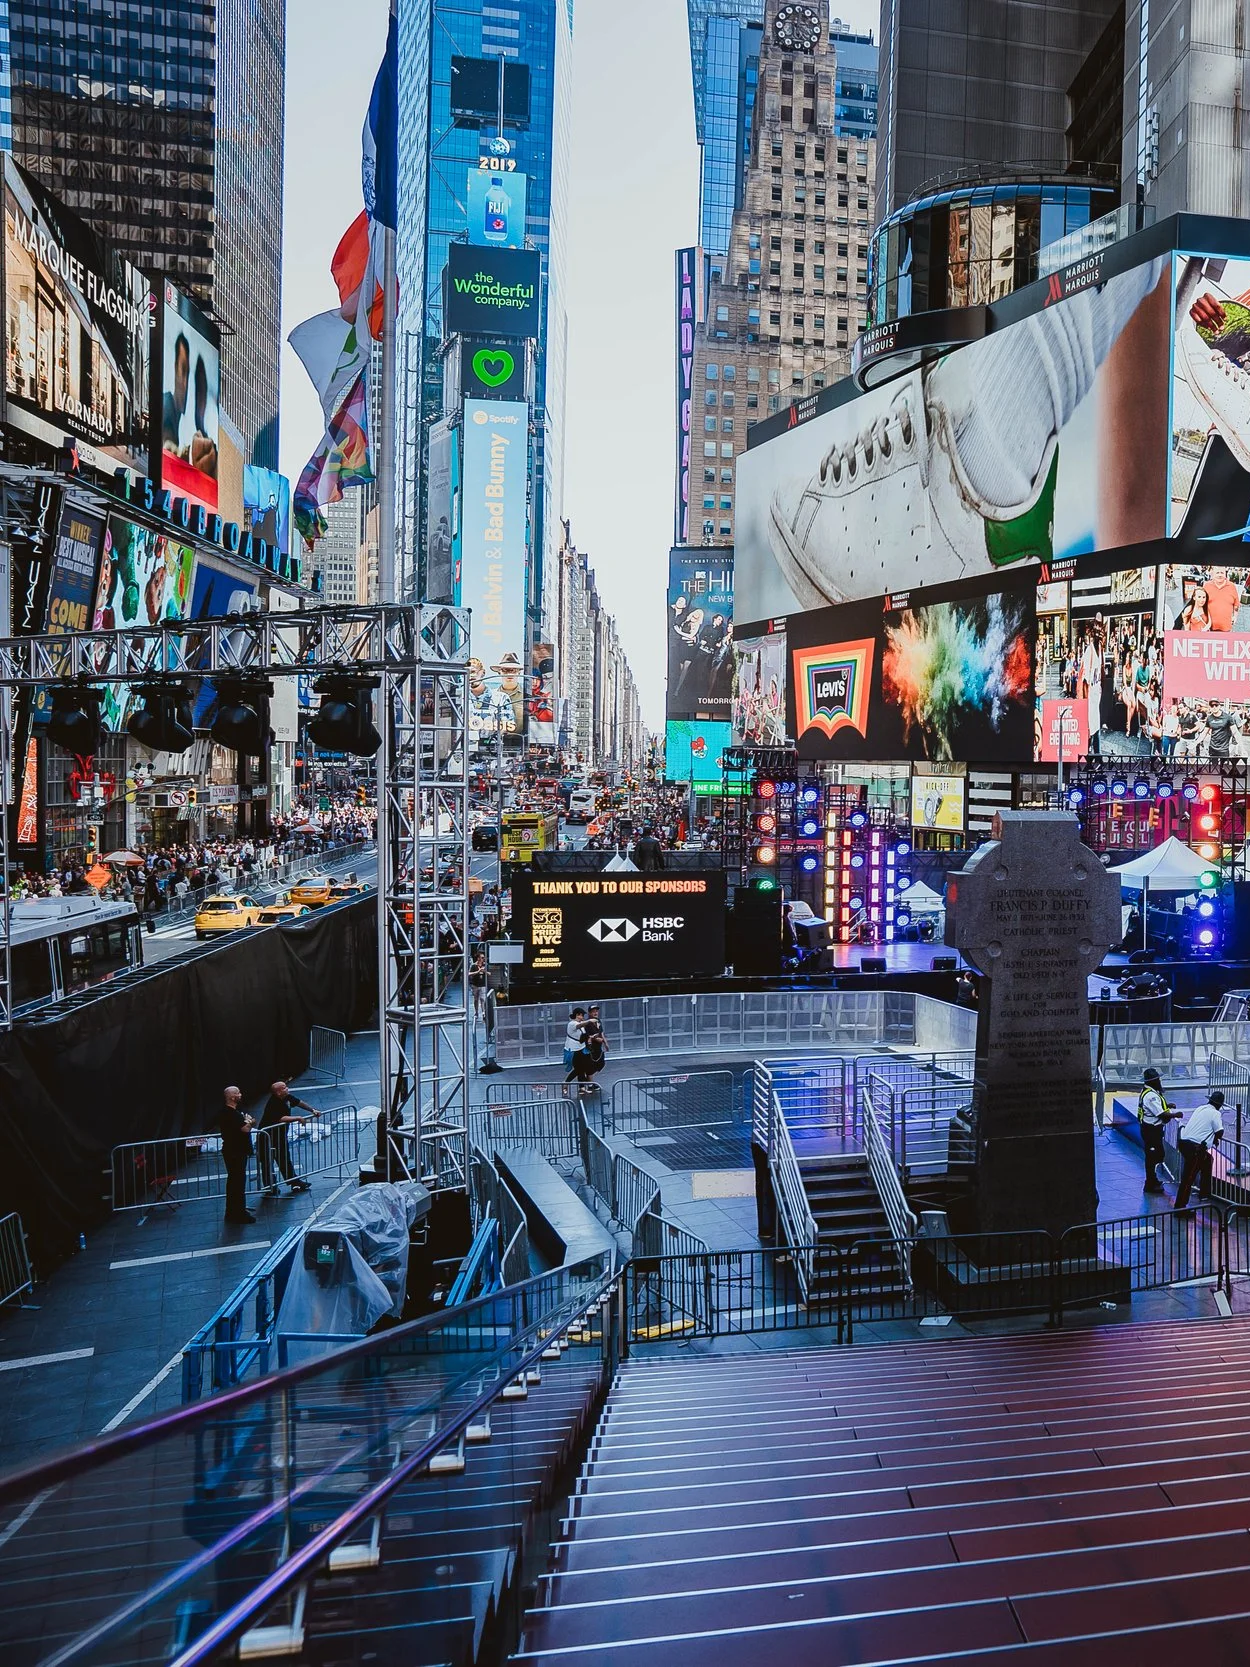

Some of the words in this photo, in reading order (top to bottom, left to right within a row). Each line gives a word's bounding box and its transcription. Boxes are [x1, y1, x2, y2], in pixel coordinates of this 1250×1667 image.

[479, 156, 517, 172] 2019
[488, 201, 505, 214] FIJI
[1065, 253, 1105, 279] MARRIOTT
[14, 208, 85, 294] MARQUEE
[87, 269, 145, 341] FLAGSHIPS
[475, 272, 493, 283] the
[1065, 268, 1100, 293] MARQUIS
[454, 278, 534, 300] Wonderful
[682, 252, 693, 388] LADY
[863, 322, 900, 344] MARRIOTT
[862, 337, 895, 357] MARQUIS
[798, 395, 819, 411] MARRIOTT
[60, 390, 113, 437] VORNADO
[489, 414, 519, 426] Spotify
[798, 407, 816, 421] MARQUIS
[67, 418, 88, 434] REALTY
[88, 429, 105, 443] TRUST
[485, 433, 510, 498] Bunny
[484, 502, 504, 542] Bad
[485, 547, 502, 560] &
[1052, 559, 1077, 570] MARRIOTT
[681, 580, 705, 593] THE
[709, 570, 735, 592] HI
[1052, 569, 1075, 580] MARQUIS
[482, 564, 503, 626] Balvin
[1114, 586, 1151, 602] SEPHORA
[51, 598, 88, 630] COME
[698, 697, 734, 705] TOMORRO
[532, 881, 573, 895] THANK
[575, 881, 600, 894] YOU
[601, 881, 618, 894] TO
[619, 881, 644, 894] OUR
[645, 880, 707, 894] SPONSORS
[997, 889, 1043, 898] LIEUTENANT
[1046, 889, 1084, 897] COLONEL
[990, 900, 1037, 911] FRANCIS
[1041, 900, 1048, 911] P
[1053, 899, 1091, 911] DUFFY
[643, 917, 684, 929] HSBC
[997, 914, 1011, 922] MAY
[643, 931, 674, 942] Bank
[1003, 928, 1044, 936] CATHOLIC
[1049, 927, 1078, 935] PRIEST
[532, 936, 562, 945] NYC
